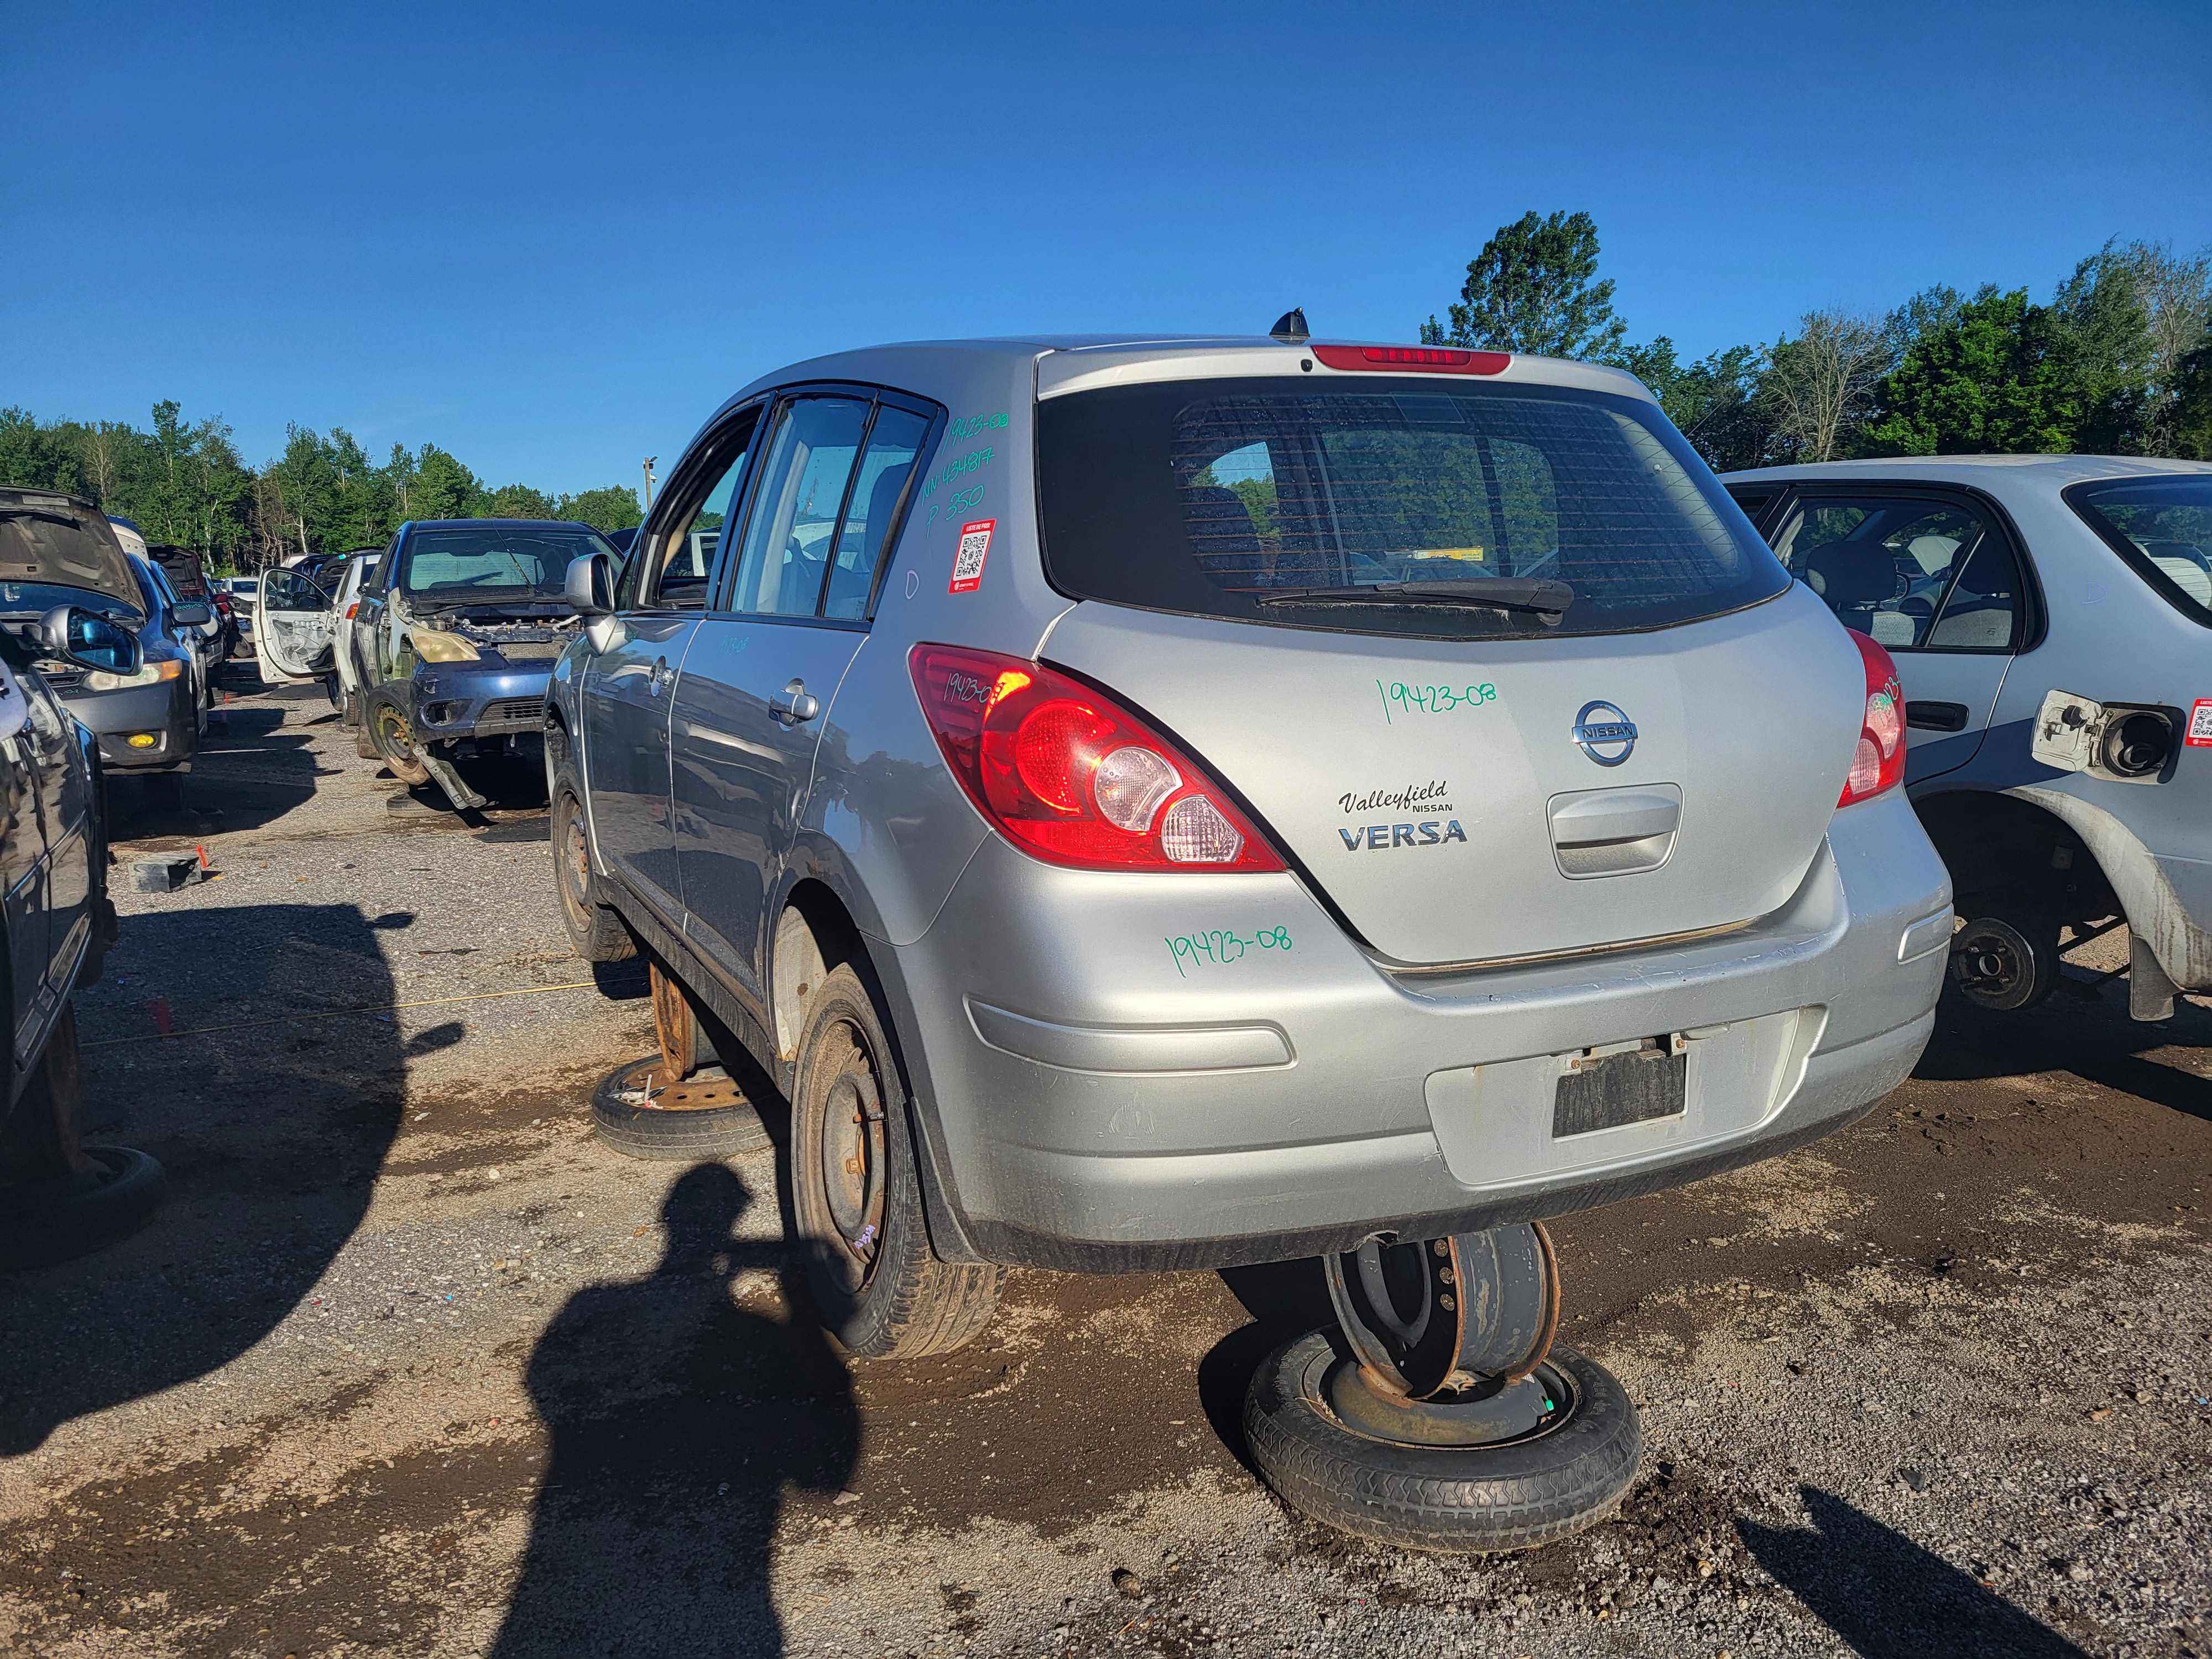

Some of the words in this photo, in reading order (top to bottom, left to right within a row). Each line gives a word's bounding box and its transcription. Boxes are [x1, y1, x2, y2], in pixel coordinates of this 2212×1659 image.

[942, 447, 995, 486] 434817
[946, 485, 984, 521] 350
[943, 672, 998, 703] 19423-0
[1376, 679, 1496, 724] 19423-08
[1582, 725, 1634, 739] NISSAN
[1338, 780, 1448, 814] Valleyfield
[1412, 804, 1453, 813] NISSAN
[1338, 819, 1468, 851] VERSA
[1164, 925, 1293, 979] 19423-08
